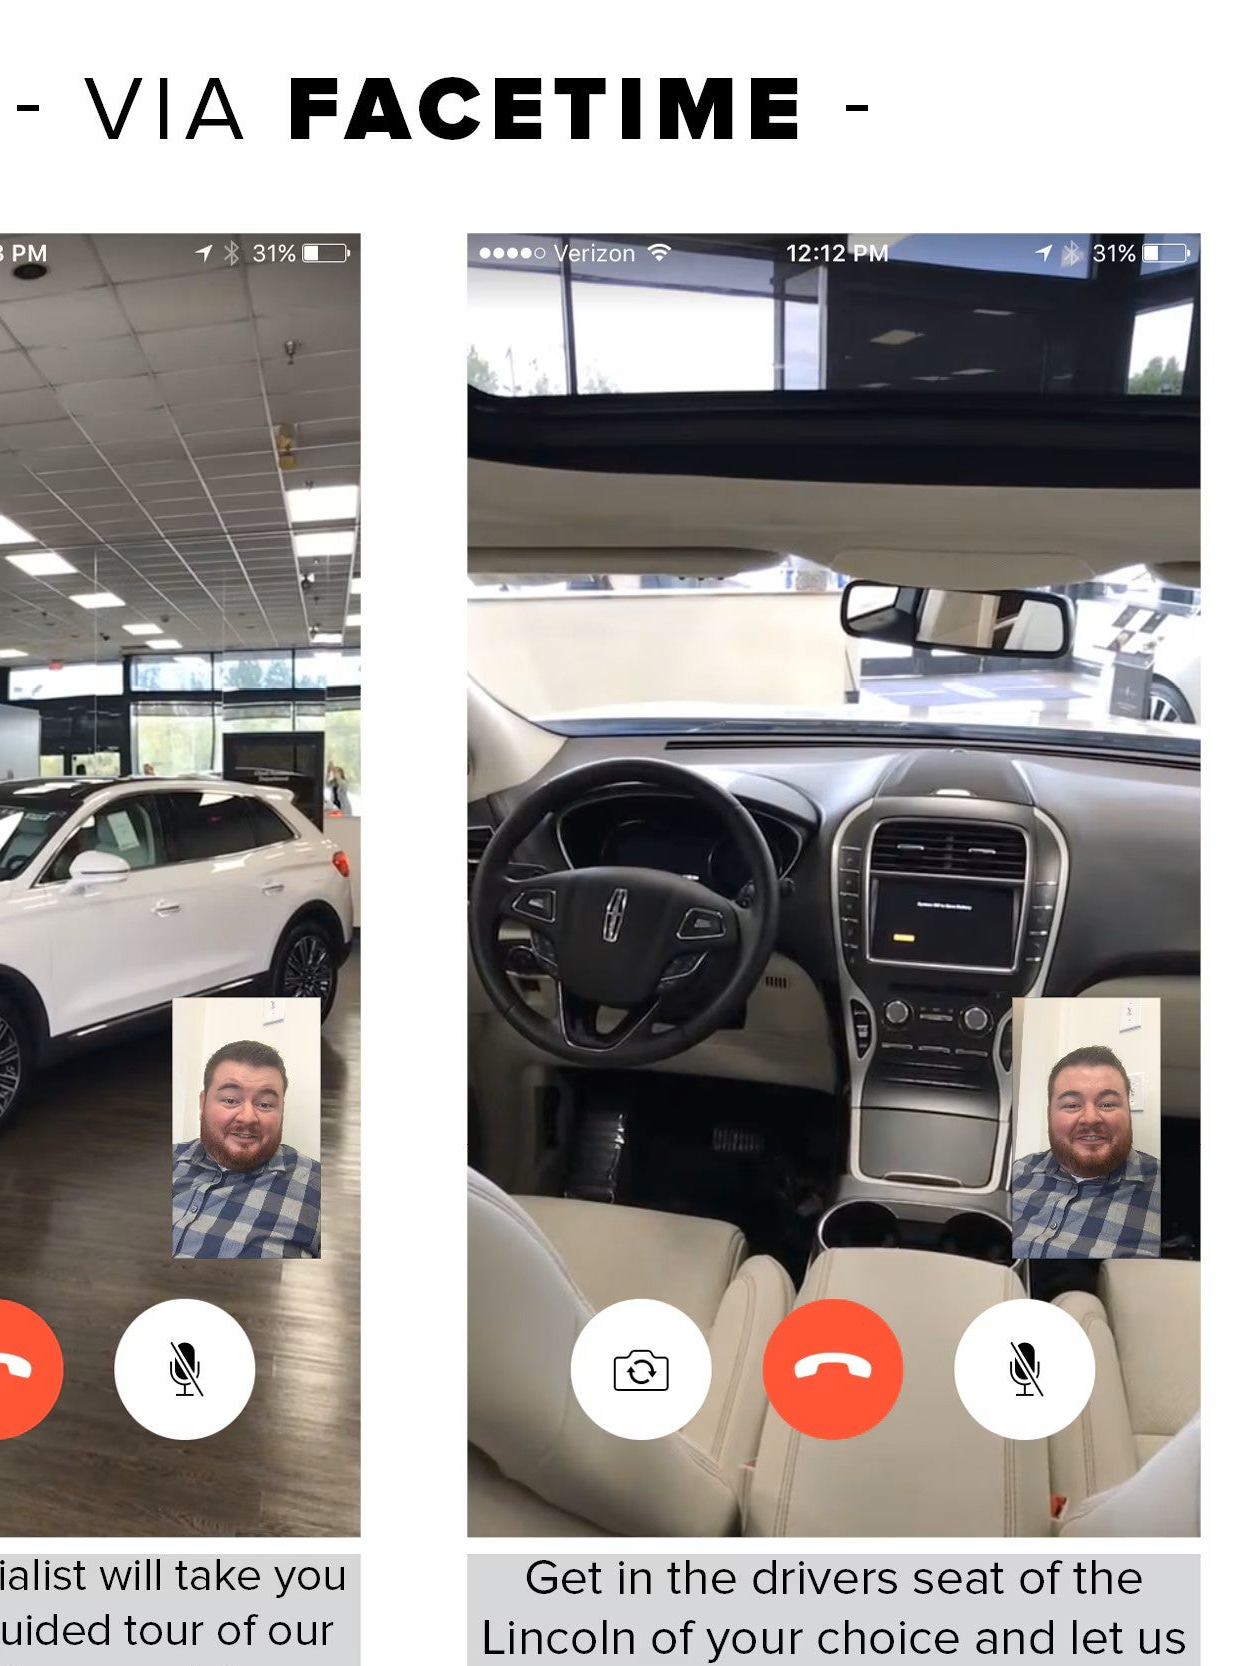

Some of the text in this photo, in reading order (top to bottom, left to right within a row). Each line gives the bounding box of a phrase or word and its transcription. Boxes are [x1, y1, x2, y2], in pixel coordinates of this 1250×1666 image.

[12, 244, 47, 262] PM
[253, 244, 296, 263] 31%
[553, 243, 635, 263] Verizon
[787, 244, 889, 262] 12:12 PM
[1093, 244, 1136, 262] 31%
